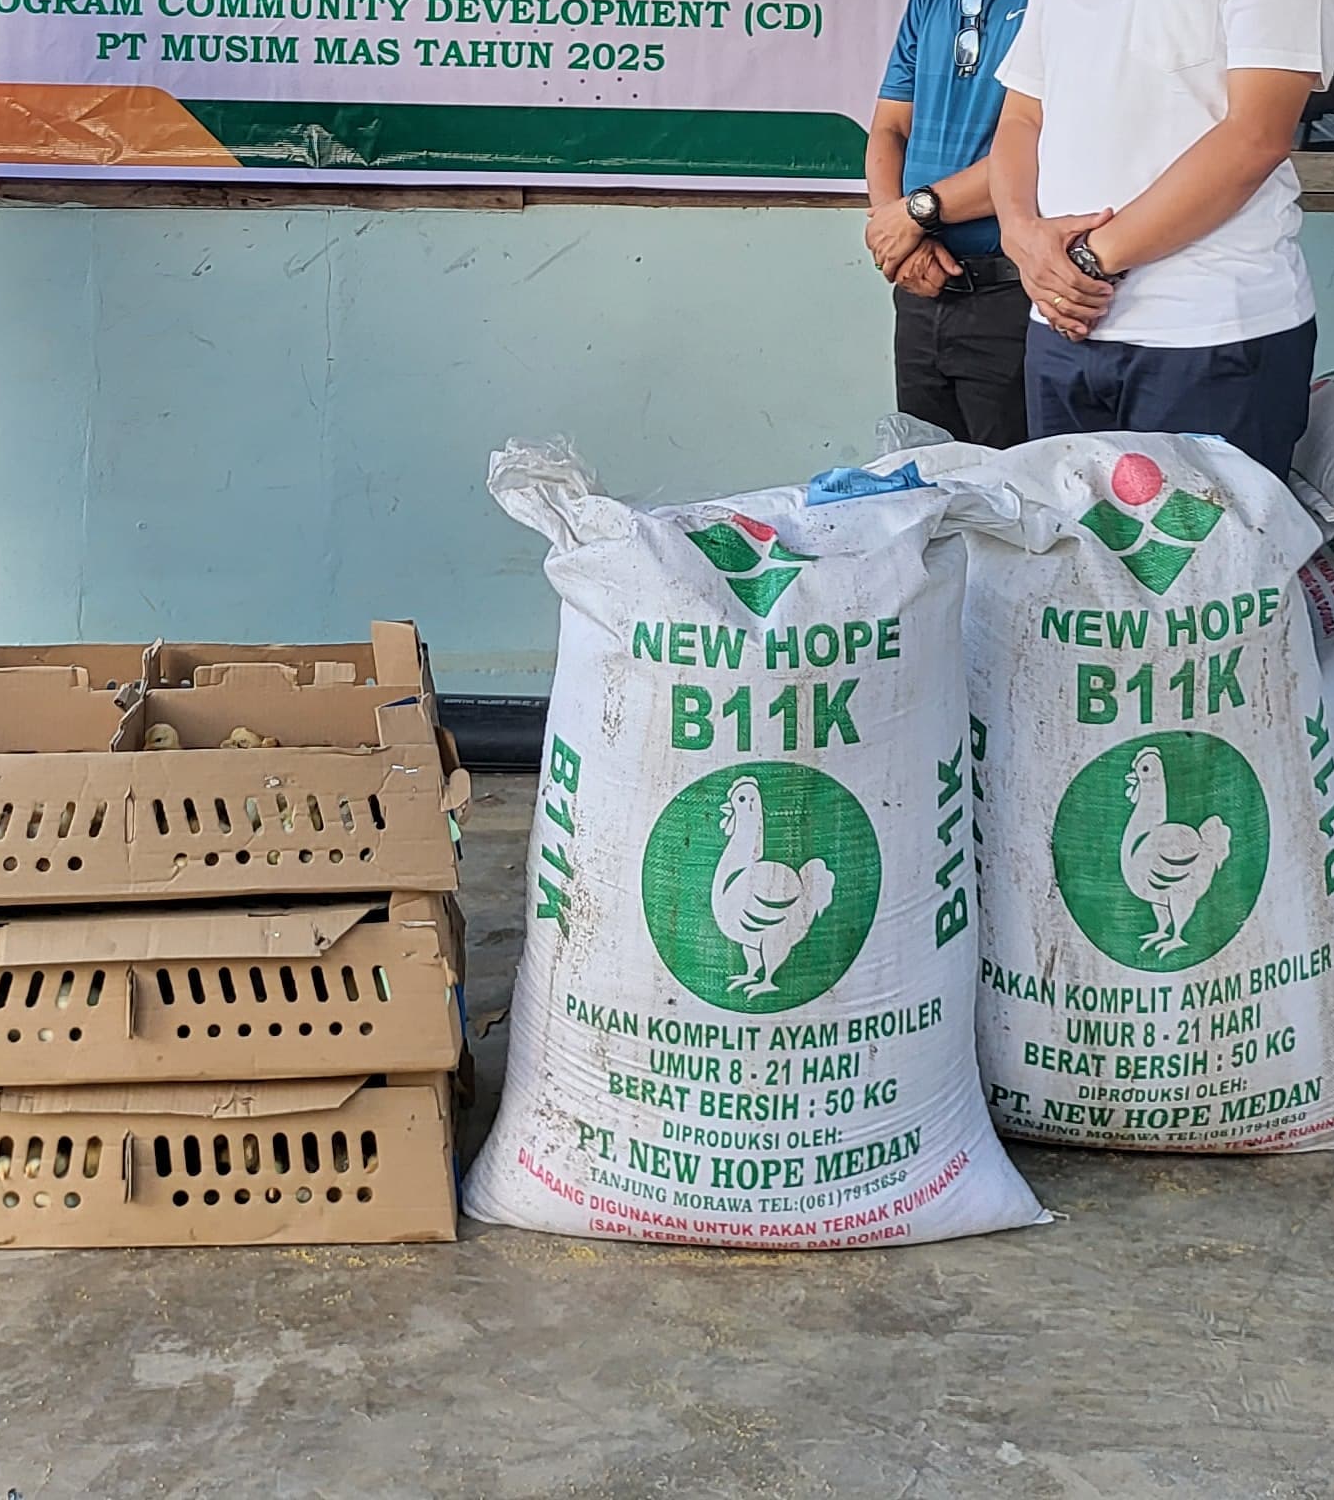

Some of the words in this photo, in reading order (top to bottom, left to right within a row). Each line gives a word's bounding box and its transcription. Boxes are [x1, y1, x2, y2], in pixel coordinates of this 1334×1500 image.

[743, 1, 824, 38] (CD)
[96, 32, 148, 61] PT
[160, 33, 300, 64] MUSIM
[313, 36, 401, 67] MAS
[414, 38, 554, 70] TAHUN
[566, 42, 667, 72] 2025
[632, 620, 747, 670] NEW
[766, 616, 902, 670] HOPE
[1041, 605, 1149, 649] NEW
[1165, 587, 1280, 647] HOPE
[1076, 645, 1246, 725] B11K
[671, 677, 862, 752] B11K
[536, 733, 583, 942] B11K
[934, 737, 968, 950] B11K
[981, 957, 1056, 1007] PAKAN
[1066, 985, 1173, 1014] KOMPLIT
[1180, 972, 1242, 1011] AYAM
[1249, 943, 1333, 994] BROILER
[566, 994, 639, 1038] PAKAN
[648, 1016, 761, 1052] KOMPLIT
[769, 1021, 839, 1052] AYAM
[848, 997, 943, 1044] BROILER
[1067, 1018, 1135, 1048] UMUR
[1143, 1020, 1156, 1048] 8
[1177, 1017, 1201, 1045] 21
[1210, 1002, 1261, 1041] HARI
[649, 1049, 720, 1084] UMUR
[729, 1054, 742, 1085] 8
[766, 1053, 793, 1084] 21
[802, 1051, 861, 1084] HARI
[1024, 1041, 1106, 1078] BERAT
[1115, 1049, 1208, 1081] BERSIH
[1231, 1038, 1258, 1069] 50
[1266, 1024, 1297, 1059] KG
[608, 1071, 689, 1113] BERAT
[699, 1088, 799, 1121] BERSIH
[825, 1087, 855, 1117] 50
[863, 1077, 899, 1107] KG
[989, 1082, 1033, 1115] PT.
[1043, 1098, 1116, 1129] NEW
[1122, 1103, 1212, 1129] HOPE
[1219, 1075, 1323, 1125] MEDAN
[1078, 1084, 1190, 1104] DIPRODUKSI
[1196, 1076, 1248, 1102] OLEH:
[663, 1121, 779, 1151] DIPRODUKSI
[788, 1126, 843, 1150] OLEH:
[1003, 1113, 1081, 1137] TANJUNG
[576, 1119, 618, 1163] PT.
[629, 1139, 701, 1185] NEW
[711, 1156, 804, 1191] HOPE
[815, 1126, 922, 1184] MEDAN
[518, 1147, 585, 1206] DILARANG
[589, 1195, 688, 1231] DIGUNAKAN
[693, 1220, 753, 1237] UNTUK
[759, 1222, 817, 1237] PAKAN
[823, 1206, 890, 1234] TERNAK
[893, 1148, 971, 1217] RUMINANSIA
[589, 1166, 667, 1203] TANJUNG
[672, 1191, 753, 1213] MORAWA
